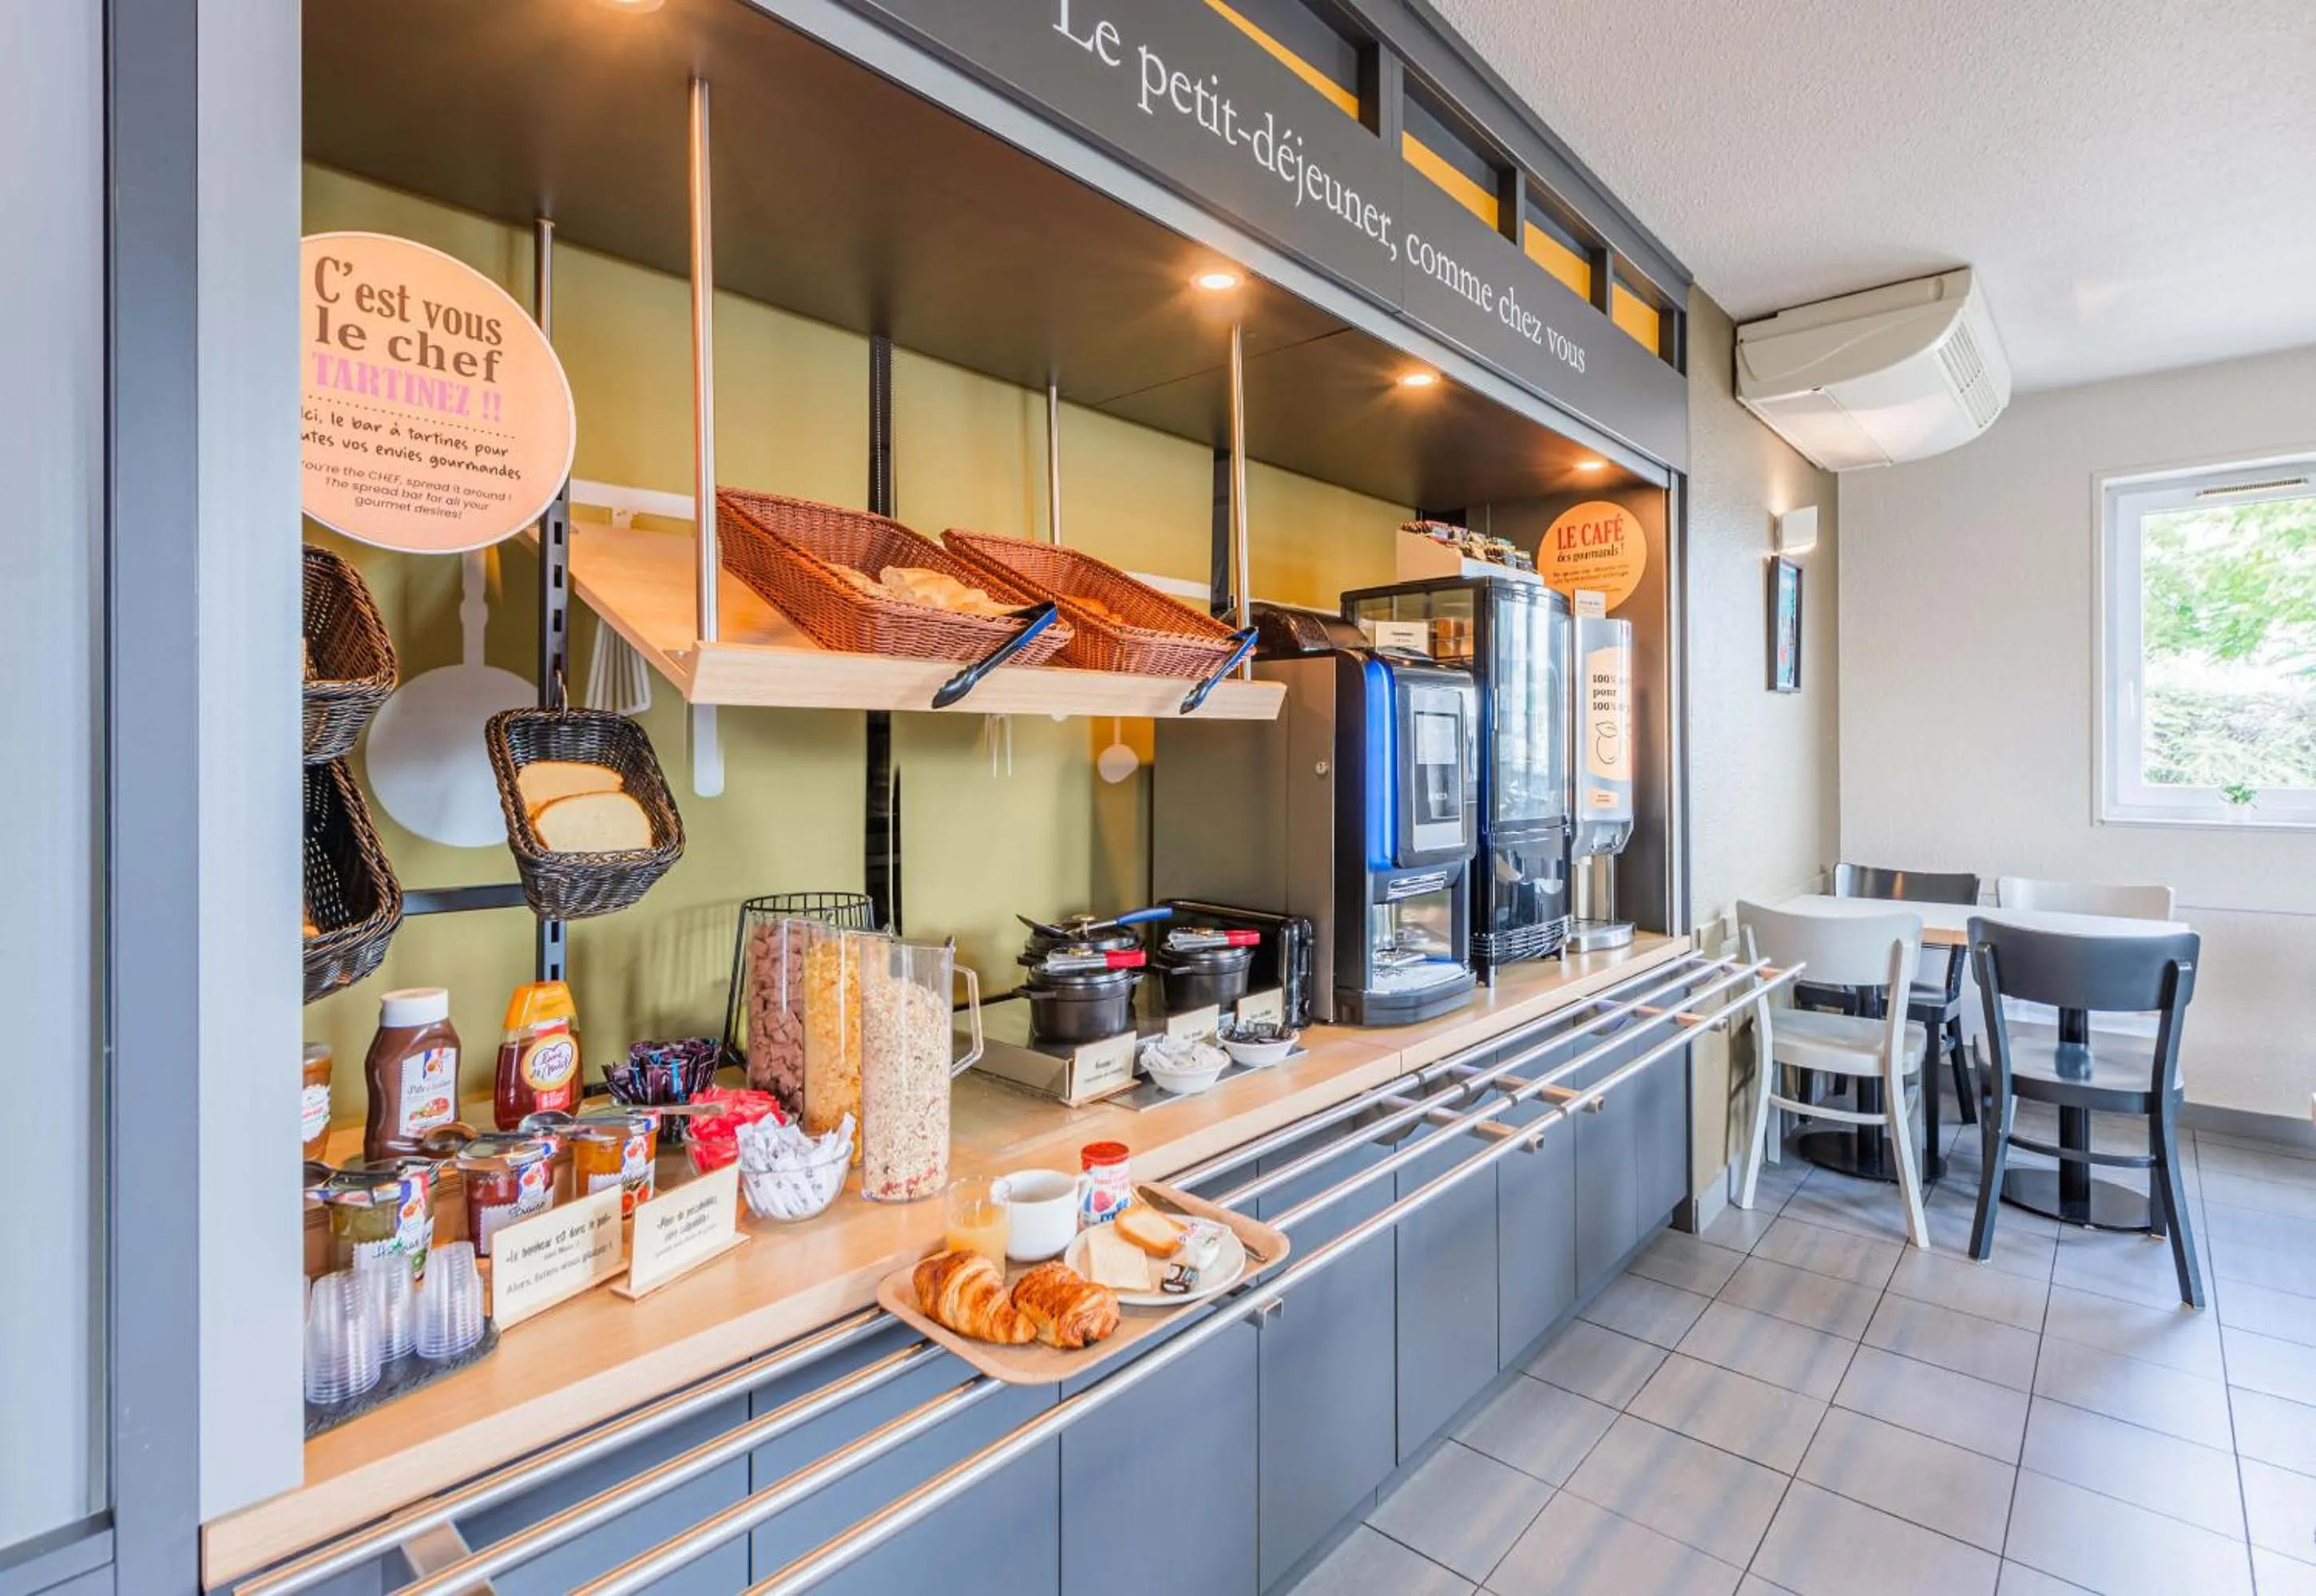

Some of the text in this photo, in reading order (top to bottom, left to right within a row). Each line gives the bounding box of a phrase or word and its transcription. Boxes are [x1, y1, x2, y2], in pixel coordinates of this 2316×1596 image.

[1137, 44, 1398, 262] petit-déjeuner,
[1406, 233, 1493, 312] comme
[1498, 287, 1542, 345] chez
[1546, 326, 1586, 374] vous
[422, 299, 503, 346] vous
[315, 306, 502, 383] le chef
[313, 353, 502, 422] TARTINEZ !!
[331, 412, 344, 427] le
[351, 417, 383, 434] bar
[390, 422, 400, 437] à
[409, 427, 468, 450] tartines
[474, 444, 509, 457] pour
[342, 440, 368, 453] vos
[376, 444, 422, 462] envies
[430, 455, 522, 481] gourmandes
[325, 477, 489, 512] The spread bar for all your
[343, 467, 365, 478] the
[406, 478, 450, 493] spread
[453, 484, 461, 493] it
[463, 488, 506, 501] around
[355, 497, 411, 513] gourmet
[1557, 513, 1624, 551] LE CAFÉ
